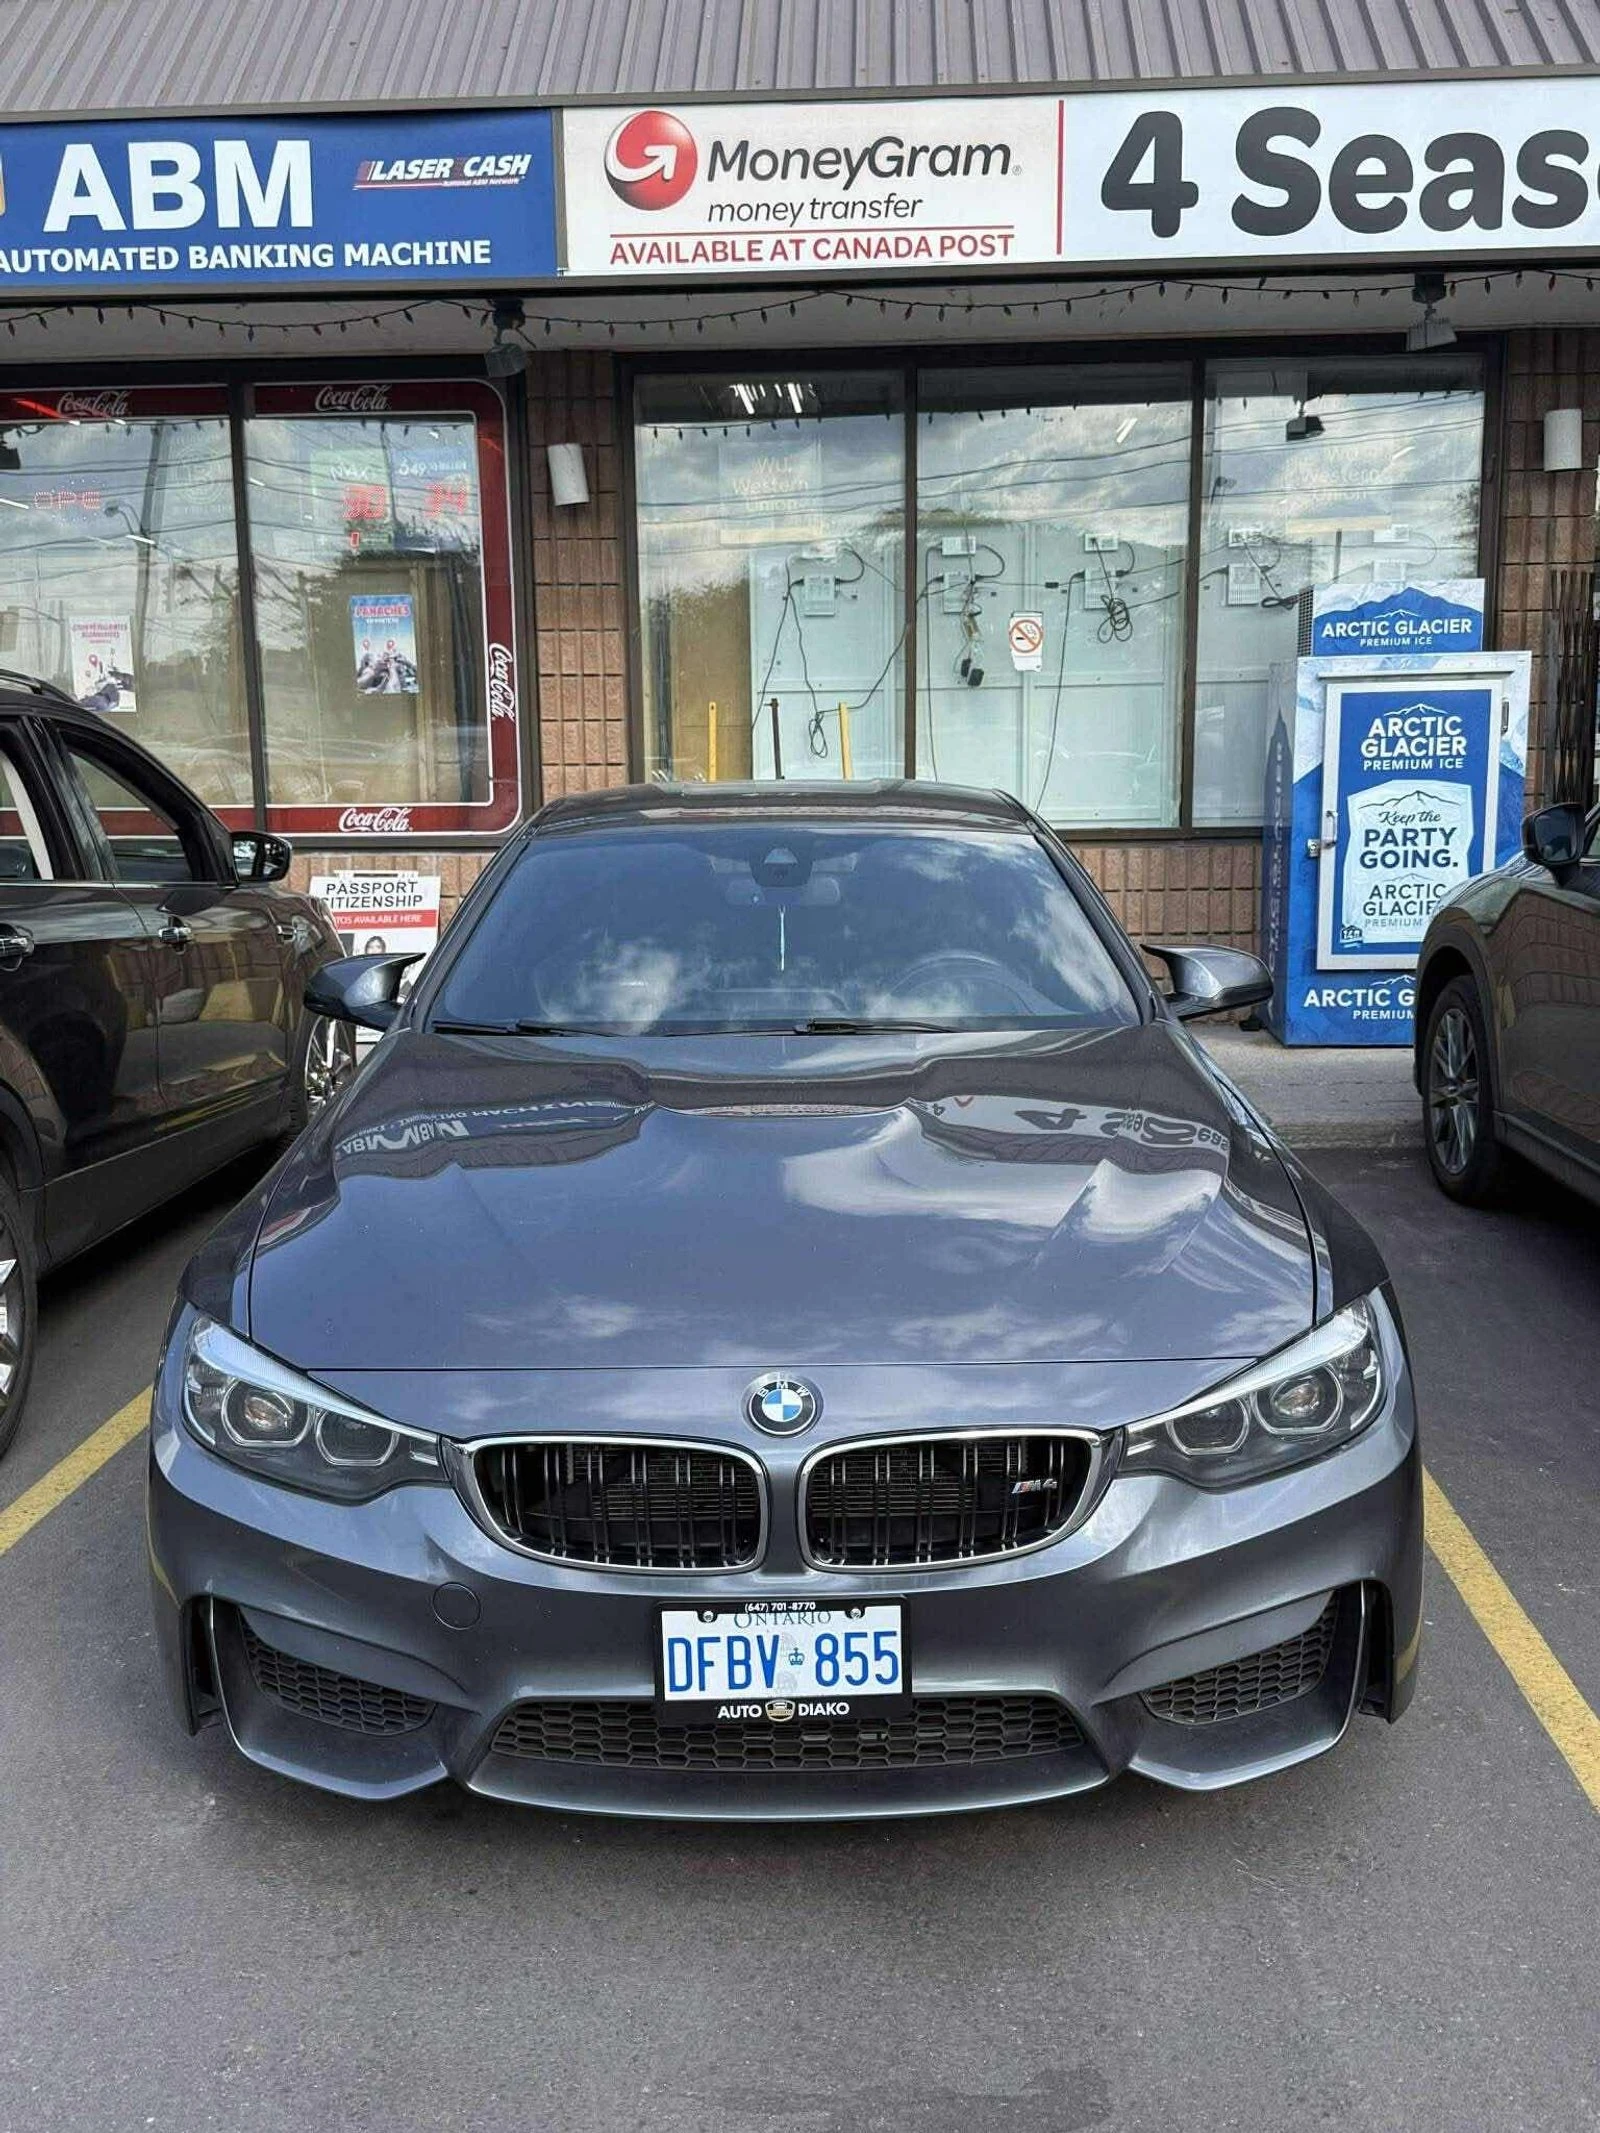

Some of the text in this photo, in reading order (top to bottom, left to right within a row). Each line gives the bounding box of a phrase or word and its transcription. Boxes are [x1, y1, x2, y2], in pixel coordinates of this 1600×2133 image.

[371, 154, 532, 180] LASER CASH
[707, 136, 1011, 190] MoneyGram
[1101, 107, 1600, 238] 4 Seas
[43, 139, 313, 233] ABM
[708, 193, 923, 227] money transfer
[0, 240, 490, 273] AUTOMATED BANKING MACHINE
[610, 234, 1014, 264] AVAILABLE AT CANADA POST
[1322, 618, 1472, 637] ARCTIC GLACIER
[1360, 637, 1432, 647] PREMIUM ICE
[1368, 716, 1462, 737] ARCTIC
[1361, 736, 1467, 758] GLACIER
[1363, 758, 1464, 771] PREMIUM ICE
[1379, 810, 1441, 826] Keep the
[1364, 827, 1457, 847] PARTY
[1360, 849, 1458, 869] GOING.
[326, 881, 418, 895] PASSPORT
[400, 914, 422, 923] HERE
[1303, 988, 1391, 1007] ARCTIC
[757, 1381, 811, 1398] BMW
[744, 1602, 769, 1613] (647)
[734, 1611, 831, 1629] ONTARIO
[667, 1631, 900, 1692] DFBV 855
[717, 1704, 762, 1718] AUTO
[798, 1702, 850, 1716] DIAKO
